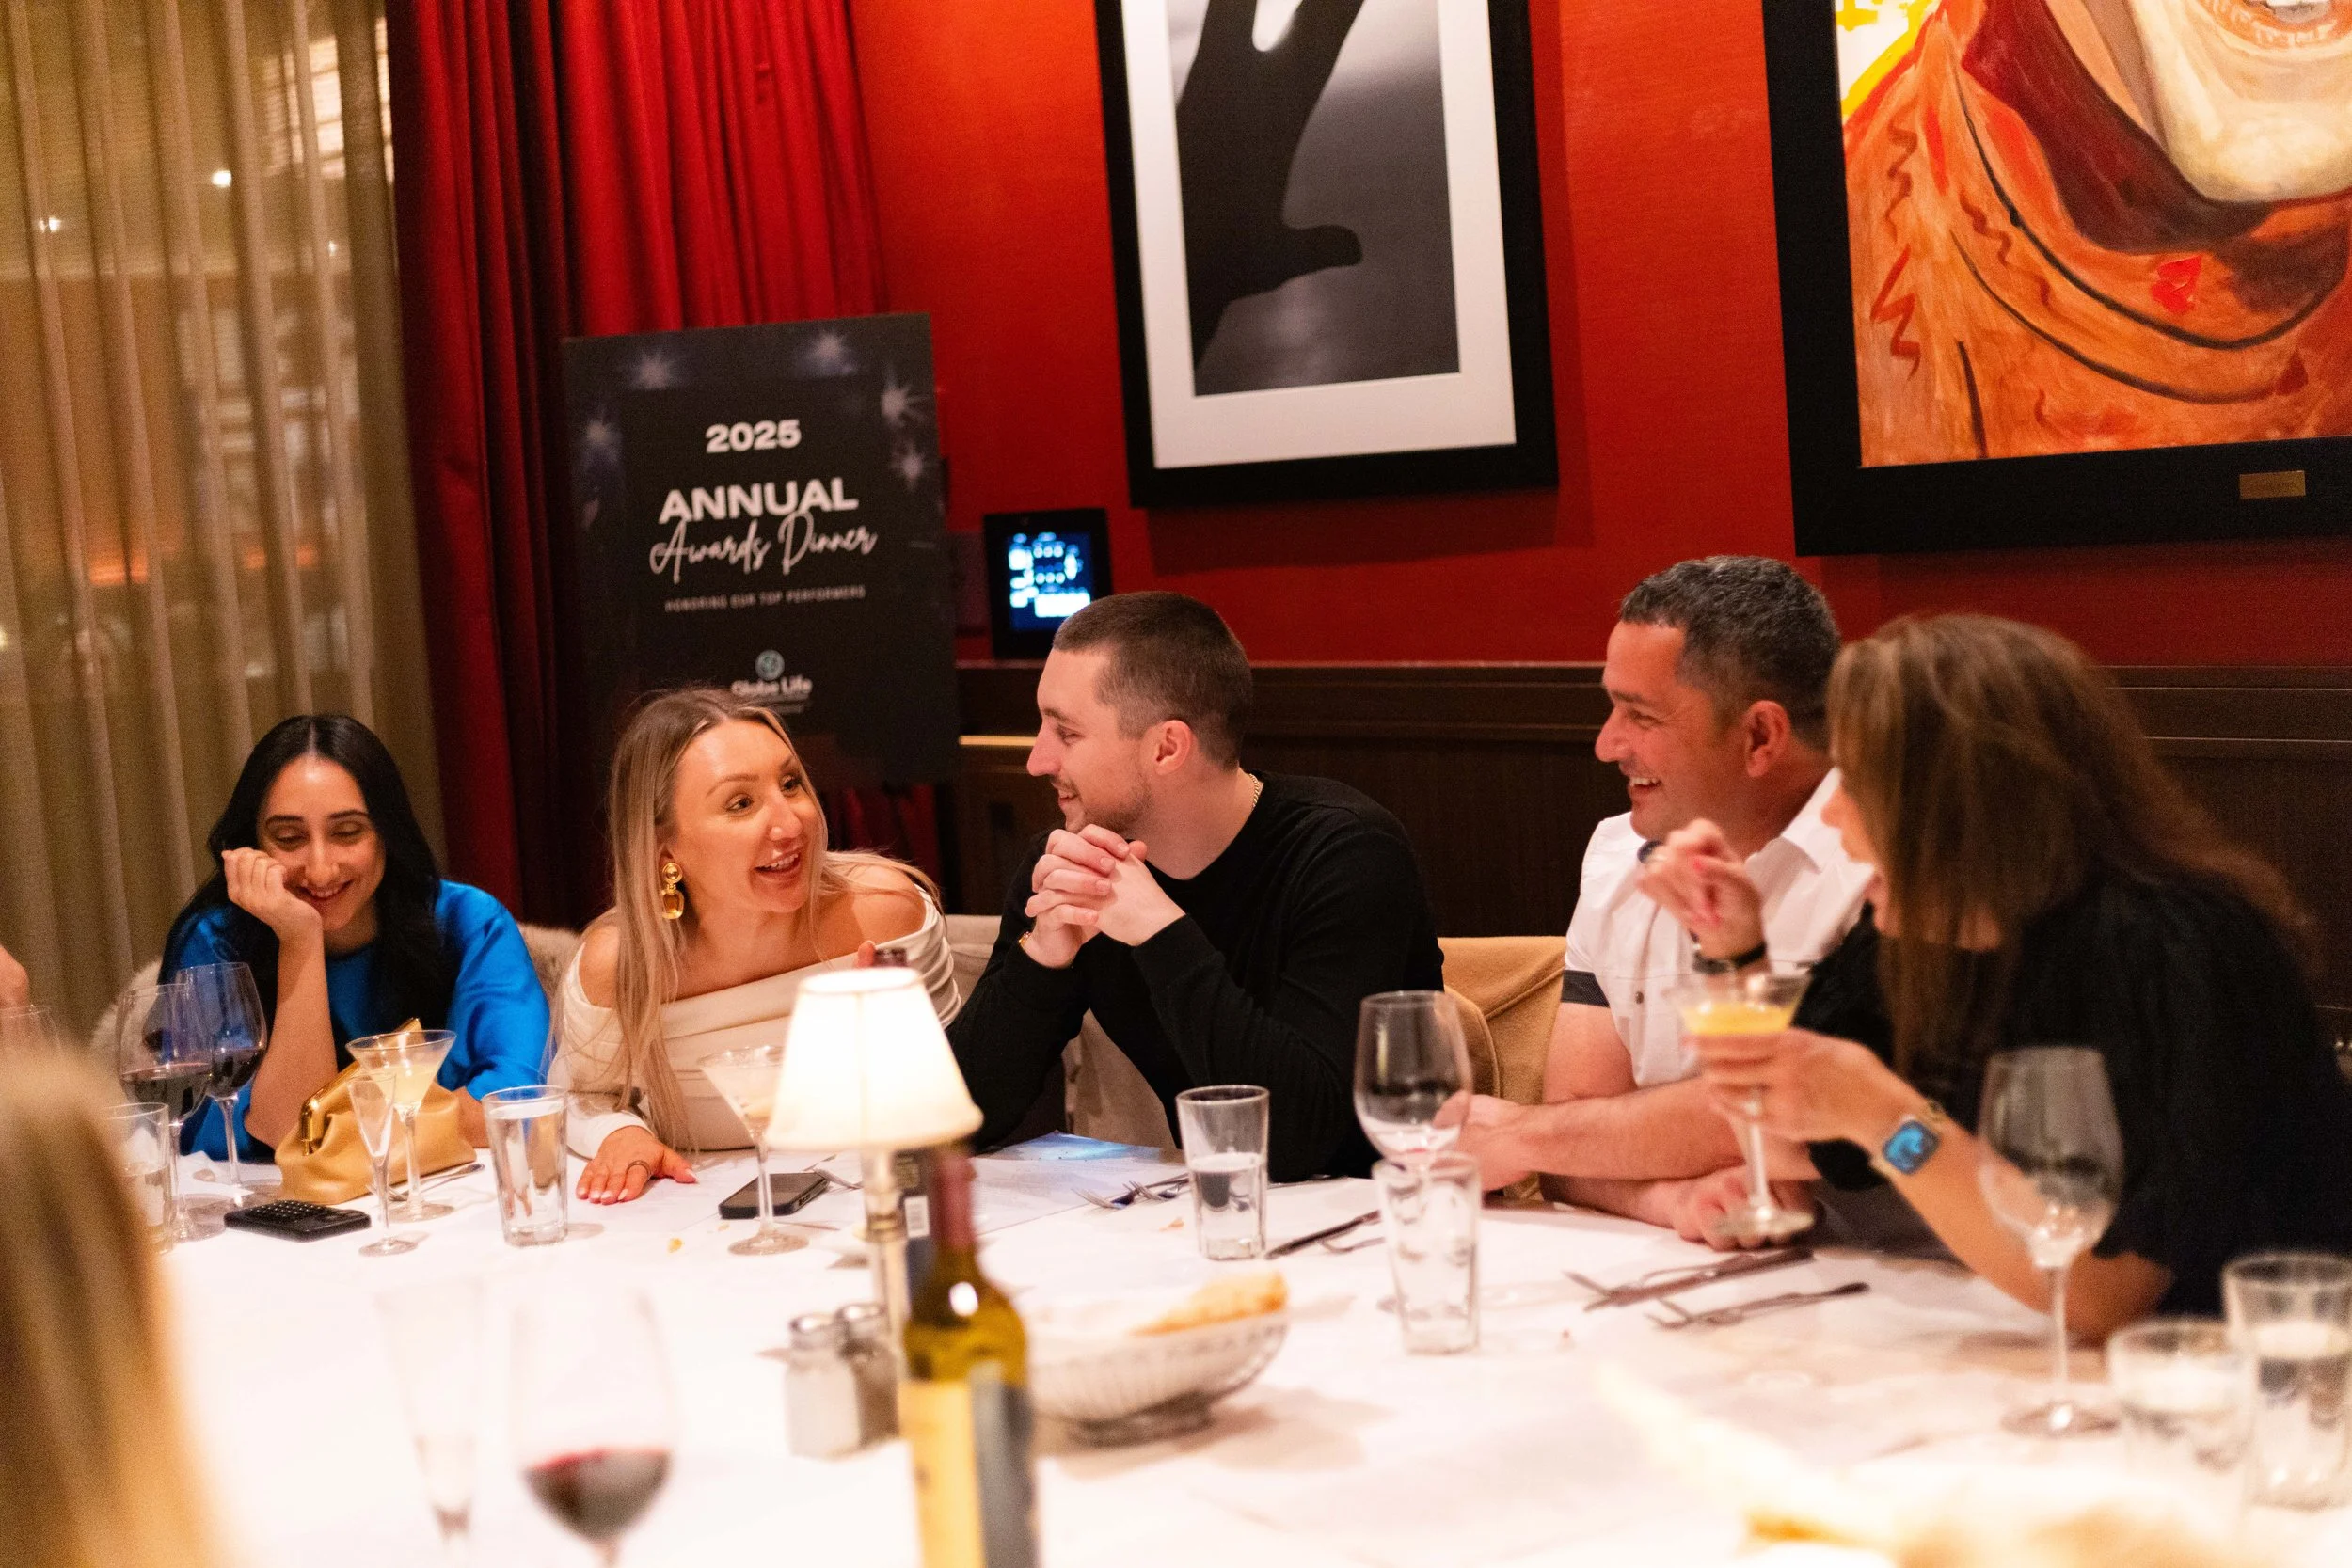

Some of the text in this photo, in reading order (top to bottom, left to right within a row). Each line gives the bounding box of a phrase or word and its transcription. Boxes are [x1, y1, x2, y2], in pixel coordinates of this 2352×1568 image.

[706, 419, 802, 453] 2025
[659, 477, 860, 525] ANNUAL
[649, 511, 879, 584] Awards Dinner
[780, 674, 813, 694] Life
